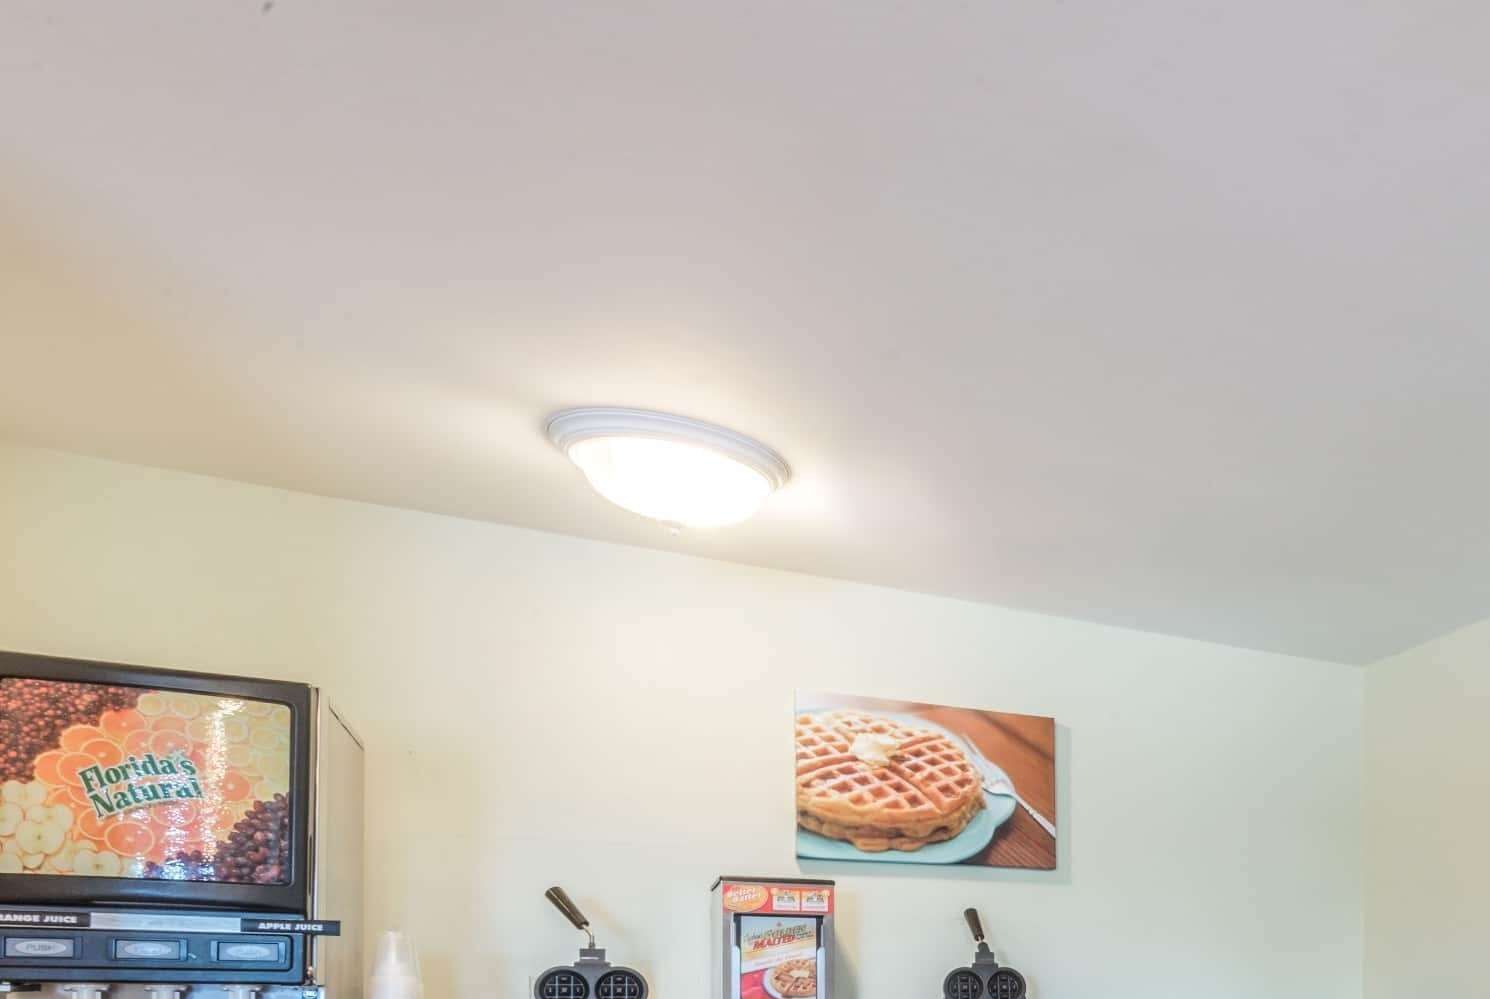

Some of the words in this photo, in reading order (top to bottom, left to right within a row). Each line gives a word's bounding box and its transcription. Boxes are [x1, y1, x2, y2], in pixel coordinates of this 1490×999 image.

[78, 753, 197, 793] Florida's
[89, 777, 203, 818] Natural
[43, 914, 78, 924] JUICE
[258, 922, 292, 931] APPLE
[294, 923, 324, 932] JUICE
